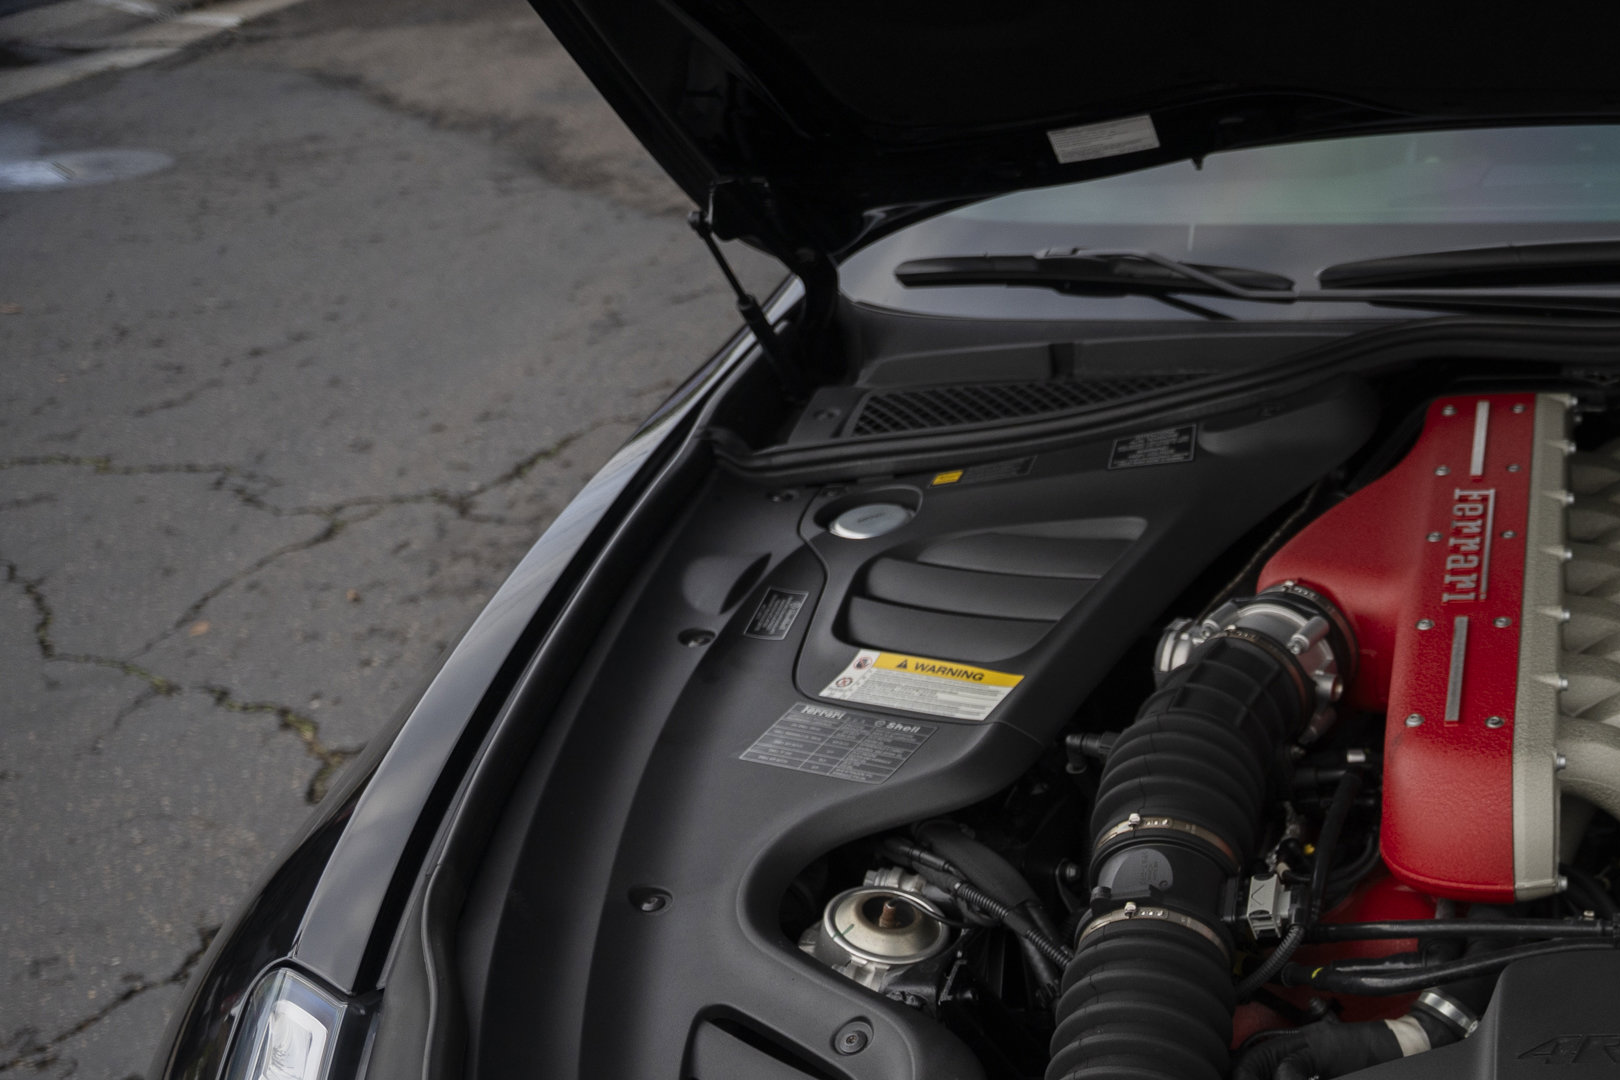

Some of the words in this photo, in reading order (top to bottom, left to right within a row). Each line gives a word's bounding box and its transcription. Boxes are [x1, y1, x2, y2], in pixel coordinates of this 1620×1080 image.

[1442, 488, 1495, 604] Ferrari
[914, 661, 984, 683] WARNING
[801, 705, 847, 720] Ferrari
[886, 722, 921, 734] Shell
